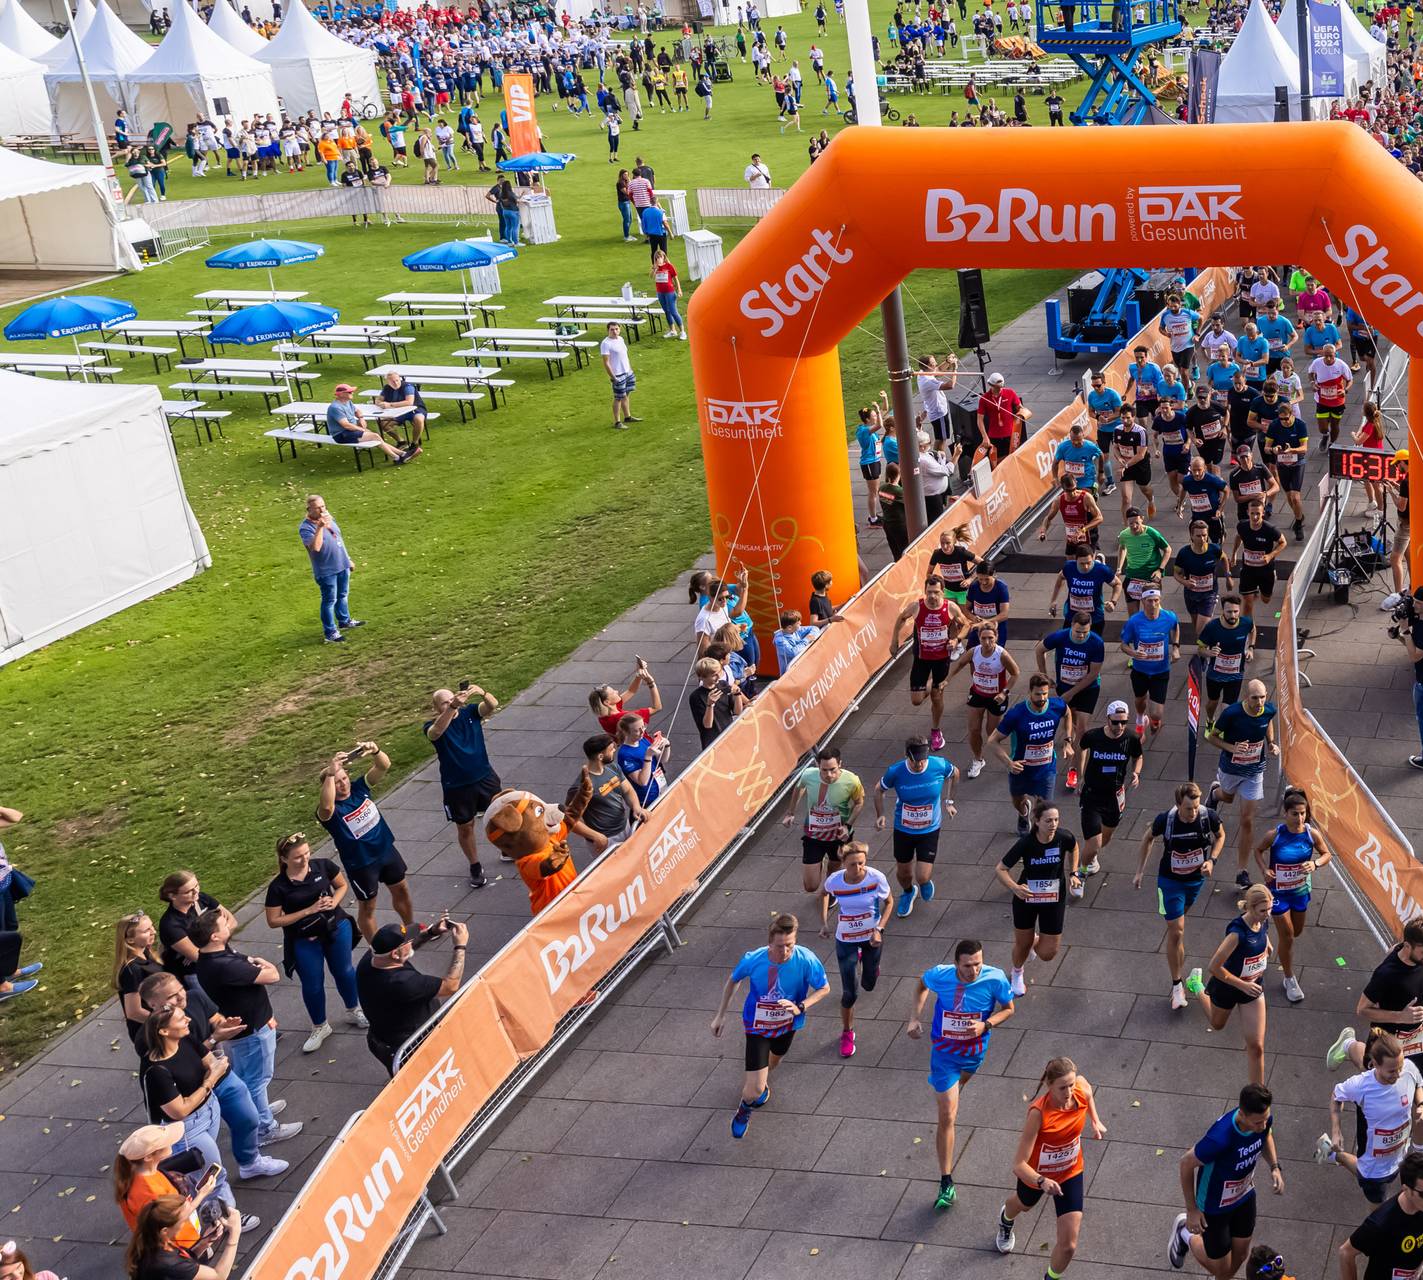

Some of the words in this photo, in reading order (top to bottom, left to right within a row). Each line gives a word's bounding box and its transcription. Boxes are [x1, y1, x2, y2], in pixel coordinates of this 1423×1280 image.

[510, 84, 532, 123] VIP
[1127, 187, 1137, 200] by
[1139, 185, 1245, 222] DAK
[925, 188, 1116, 243] B2Run
[1127, 203, 1137, 242] powered
[1140, 221, 1247, 242] Gesundheit
[740, 228, 854, 337] Start
[61, 323, 98, 335] ERDINGER
[255, 331, 291, 341] ERDINGER
[707, 398, 780, 425] DAK
[711, 422, 784, 439] Gesundheit
[1072, 577, 1095, 587] Team
[1064, 647, 1087, 659] Team
[1028, 719, 1055, 731] Team
[1028, 729, 1055, 741] RWE
[648, 808, 693, 872] DAK
[652, 830, 701, 887] Gesundheit
[1035, 880, 1053, 889] 1854
[848, 919, 863, 927] 346
[540, 874, 647, 995] B2Run
[765, 1009, 786, 1018] 1982
[394, 1047, 461, 1138] DAK
[406, 1074, 468, 1153] Gesundheit
[1047, 1144, 1074, 1160] 14257
[1238, 1138, 1262, 1159] Team
[283, 1147, 404, 1280] 2Run
